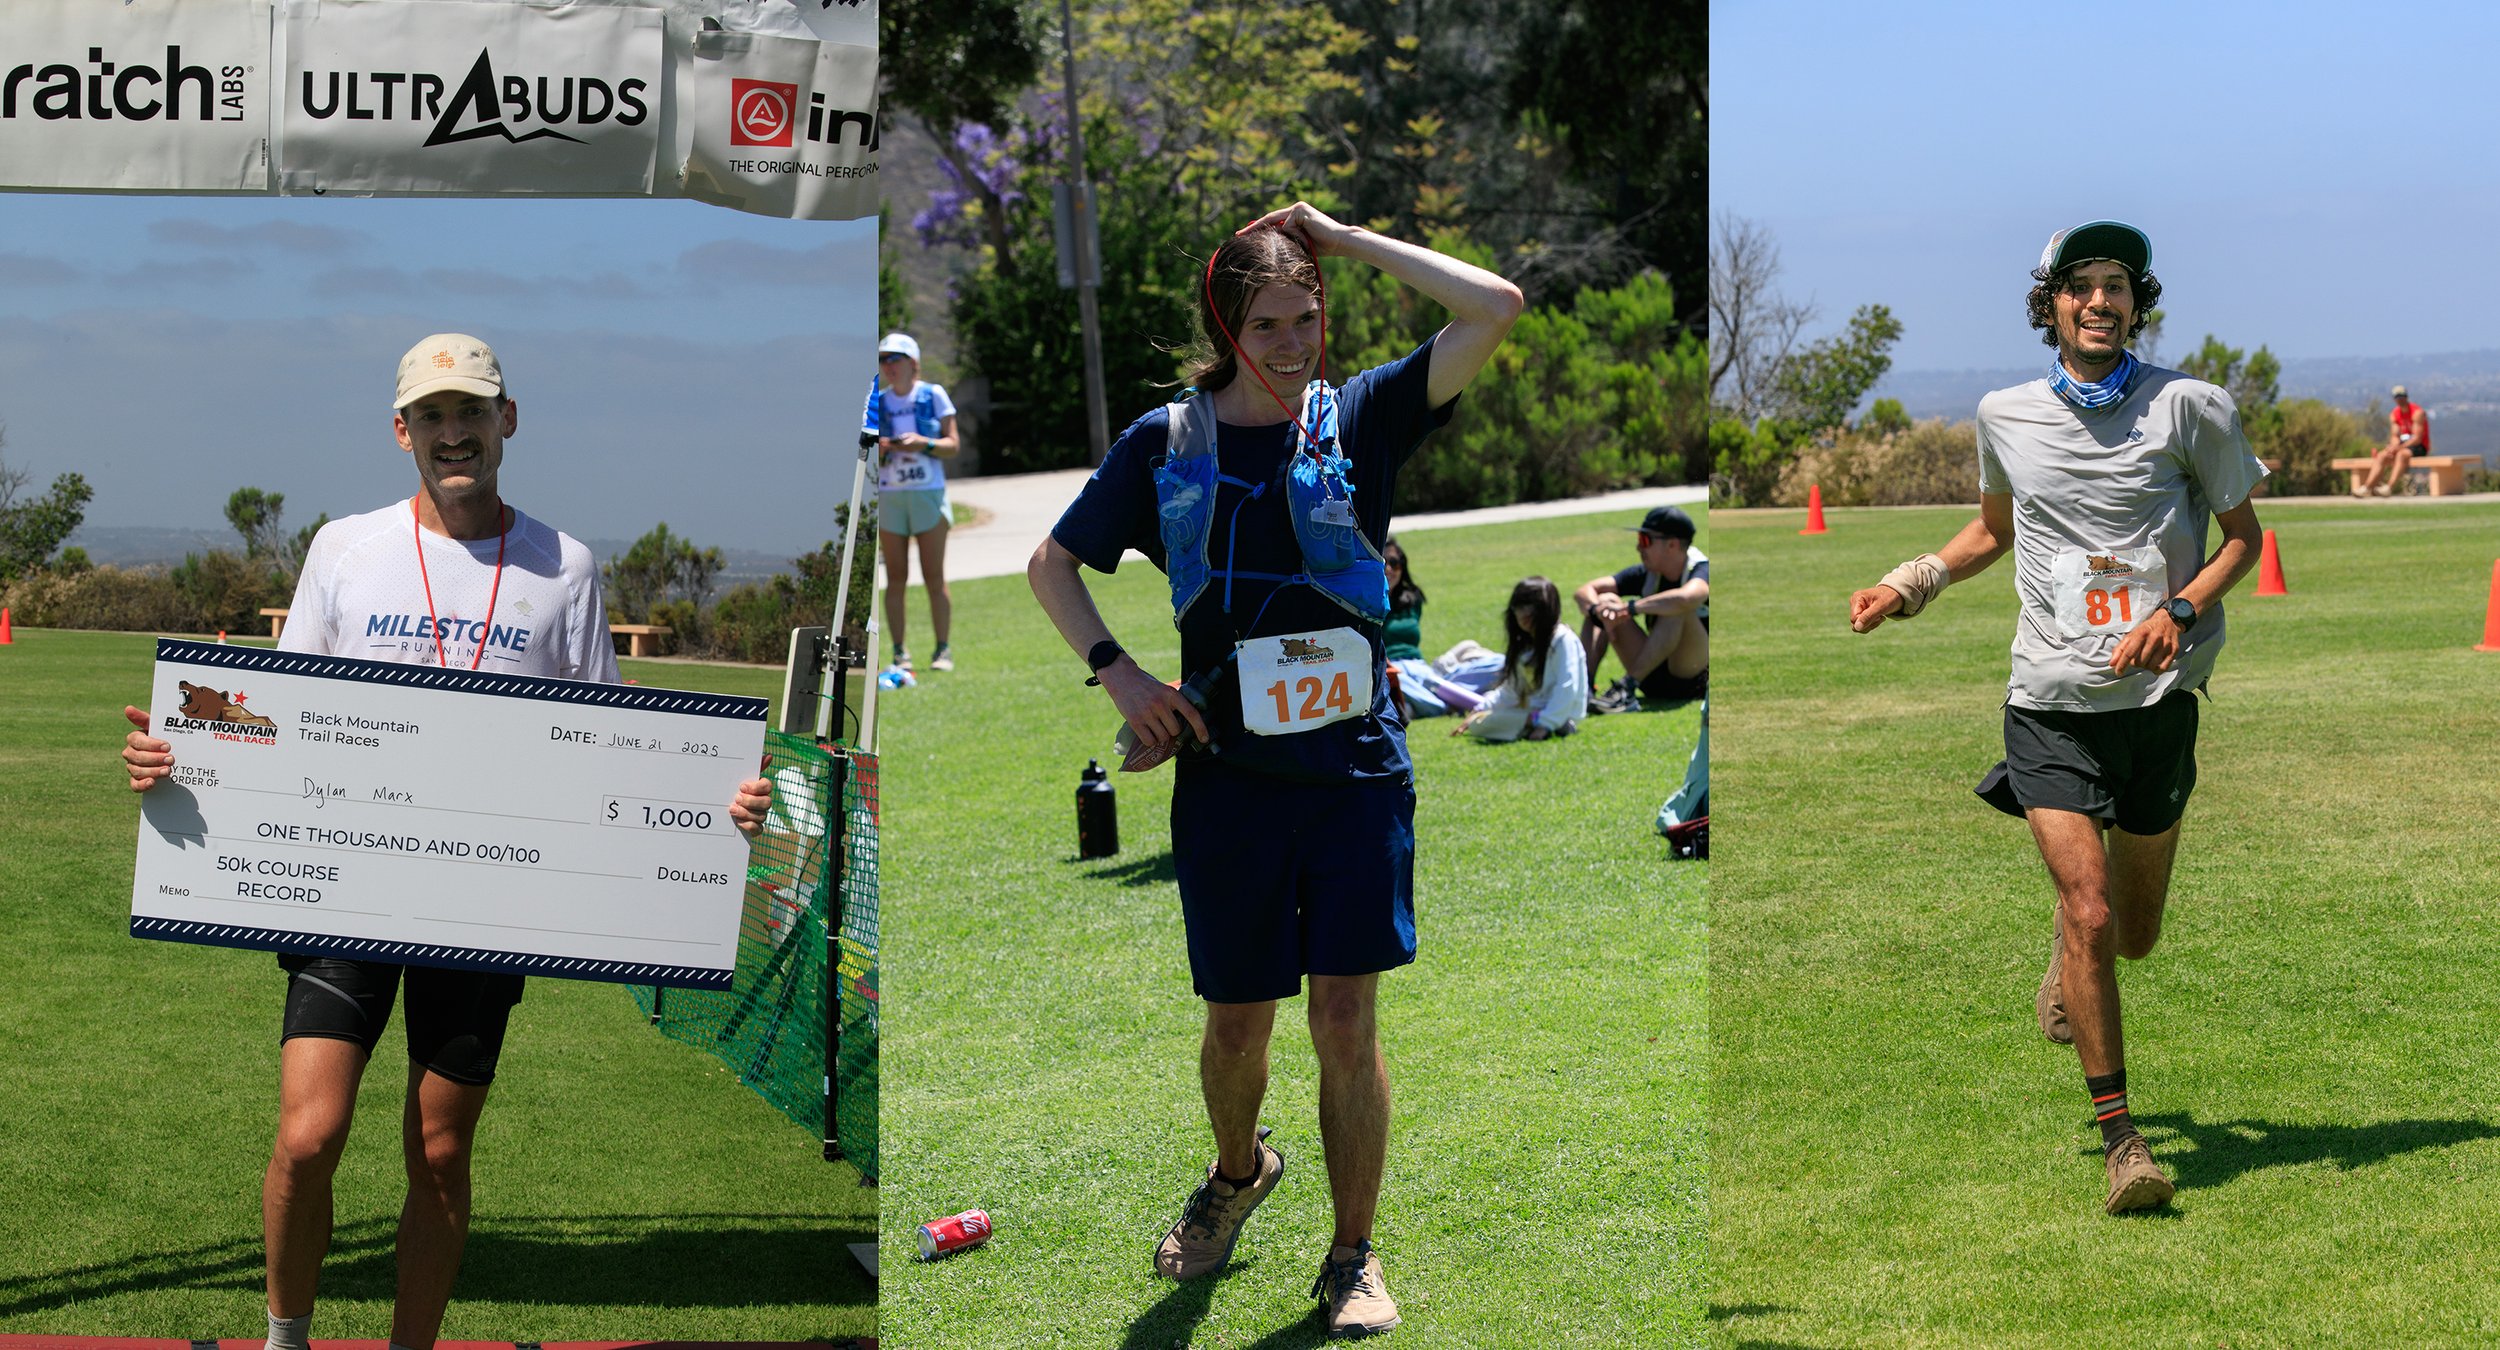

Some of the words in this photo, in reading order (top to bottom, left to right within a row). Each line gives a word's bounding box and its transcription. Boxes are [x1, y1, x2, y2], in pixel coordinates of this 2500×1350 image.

[0, 45, 214, 121] ratch
[221, 65, 244, 121] LABS
[303, 46, 648, 146] ULTRABUDS
[729, 160, 754, 172] THE
[757, 160, 822, 177] ORIGINAL
[2085, 585, 2133, 626] 81
[365, 614, 530, 652] MILESTONE
[401, 641, 490, 660] RUNNING
[421, 656, 437, 664] SAN
[441, 660, 466, 668] IEGO
[1277, 656, 1299, 664] BLACK
[1300, 652, 1334, 661] MOUNTAIN
[1267, 671, 1353, 723] 124
[164, 716, 208, 731] BLACK
[209, 721, 278, 738] MOUNTAIN
[300, 711, 342, 727] Black
[346, 715, 420, 735] Mountain
[213, 732, 242, 743] TRAIL
[243, 736, 276, 746] RACES
[299, 728, 330, 743] Trail
[335, 732, 380, 748] Races
[607, 733, 642, 749] JUNE
[648, 738, 662, 750] 21
[681, 741, 719, 757] 2025
[171, 775, 204, 786] ORDER
[206, 778, 220, 787] OF
[181, 766, 194, 776] TO
[196, 767, 216, 778] THE
[301, 776, 346, 809] Dylan
[372, 786, 414, 804] Marx
[606, 799, 619, 821] $
[642, 806, 712, 829] 1,000
[256, 822, 300, 842] ONE
[305, 826, 420, 853] THOUSAND
[425, 839, 471, 857] AND
[475, 843, 541, 864] 00/100
[216, 855, 252, 873] 50k
[257, 859, 340, 882] COURSE
[236, 881, 322, 904] RECORD
